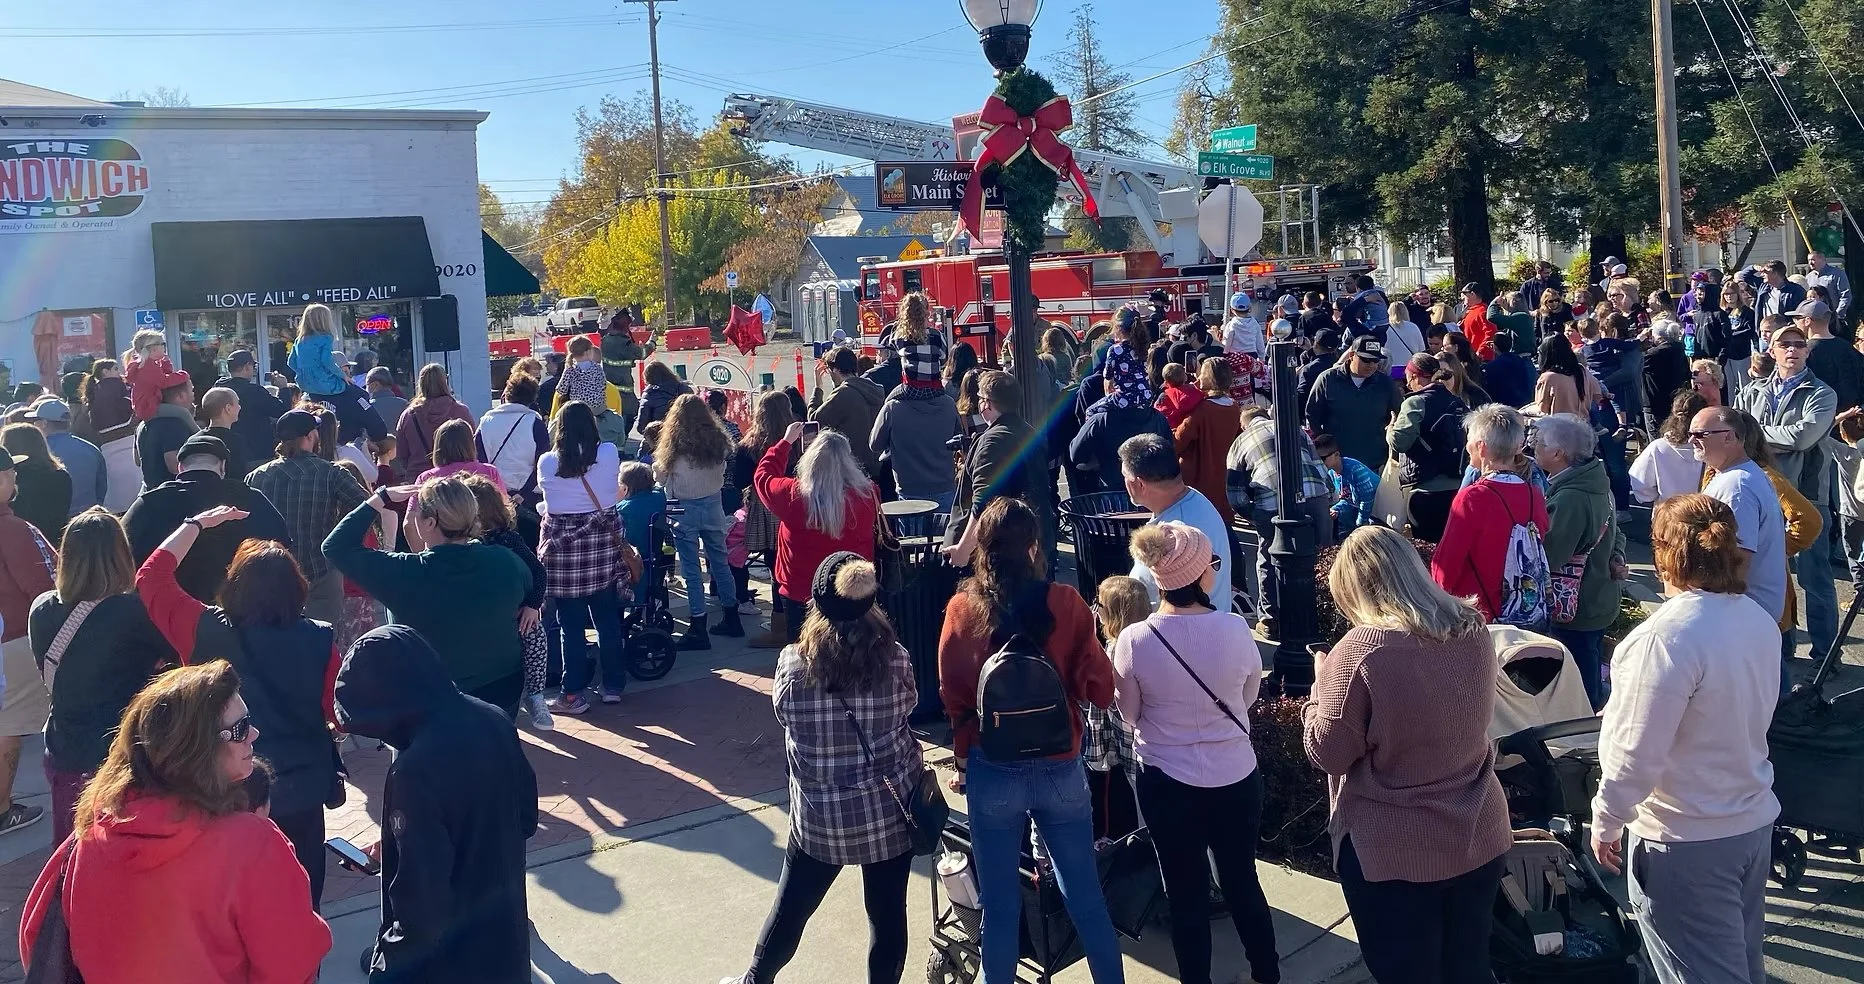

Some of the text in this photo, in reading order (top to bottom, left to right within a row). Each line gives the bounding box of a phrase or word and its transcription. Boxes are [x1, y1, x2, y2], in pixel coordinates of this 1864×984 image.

[961, 114, 980, 125] WELCO
[7, 142, 90, 155] THE
[1222, 136, 1245, 149] Walnut
[932, 168, 972, 181] Histori
[1213, 162, 1228, 174] Elk
[1230, 163, 1256, 175] Grove
[912, 183, 998, 199] Main Set
[2, 201, 102, 217] SPOT
[71, 220, 114, 230] Operated
[434, 263, 476, 277] 9020
[207, 286, 396, 308] "LOVE ALL" "FEED ALL"
[357, 318, 392, 332] OPEN
[712, 367, 729, 381] 9020
